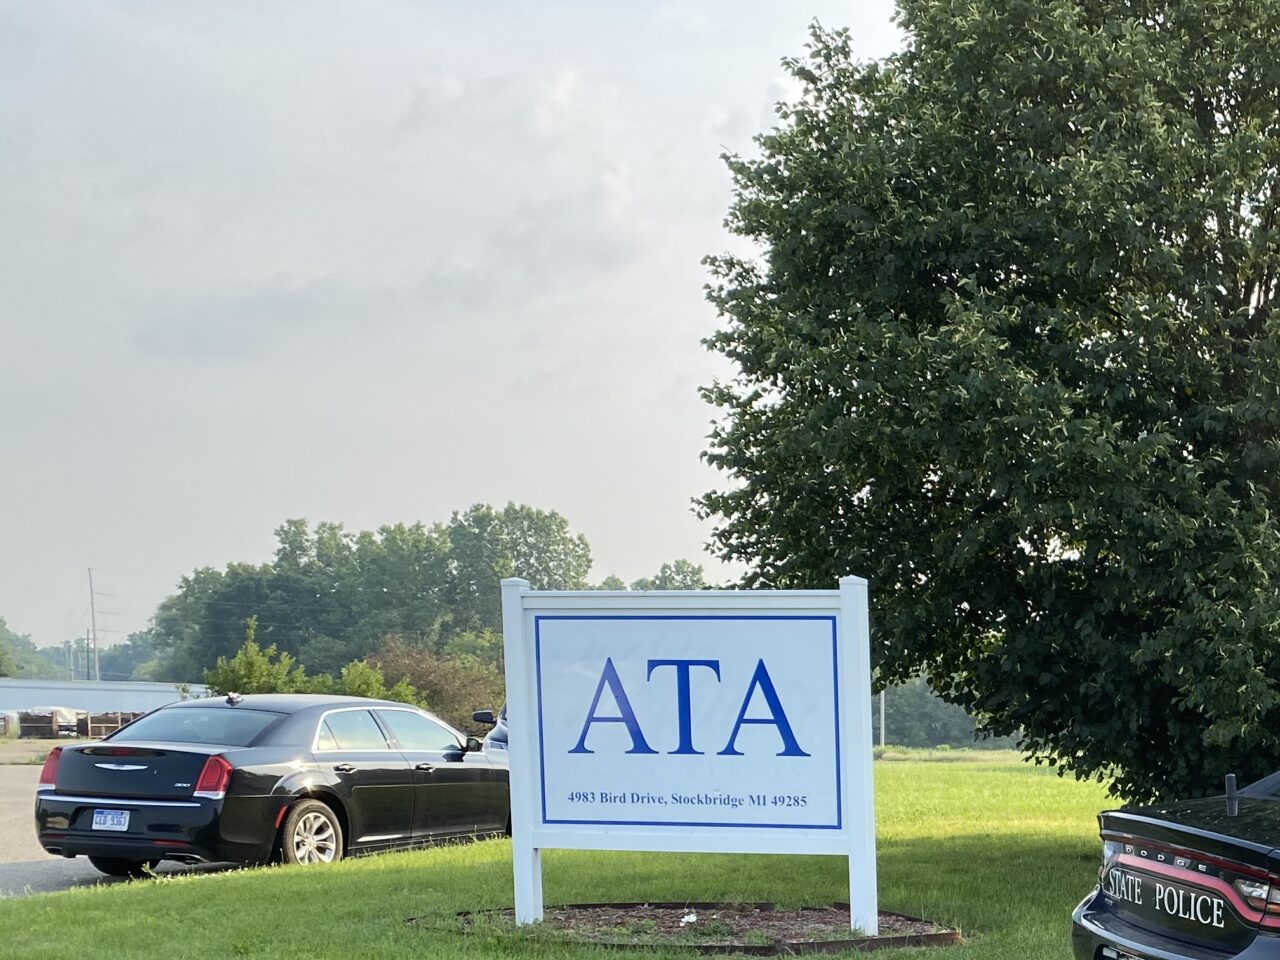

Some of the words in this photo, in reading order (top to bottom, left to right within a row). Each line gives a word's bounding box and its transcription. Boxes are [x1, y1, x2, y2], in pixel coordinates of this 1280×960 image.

[567, 657, 811, 757] ATA
[567, 791, 596, 803] 4983
[600, 792, 626, 804] Bird
[630, 792, 667, 806] Drive,
[671, 793, 745, 809] Stockbridge
[748, 794, 767, 806] MI
[770, 795, 807, 808] 49285
[1125, 845, 1207, 872] DODGE
[1109, 869, 1142, 905] STATE
[1155, 883, 1224, 928] POLICE
